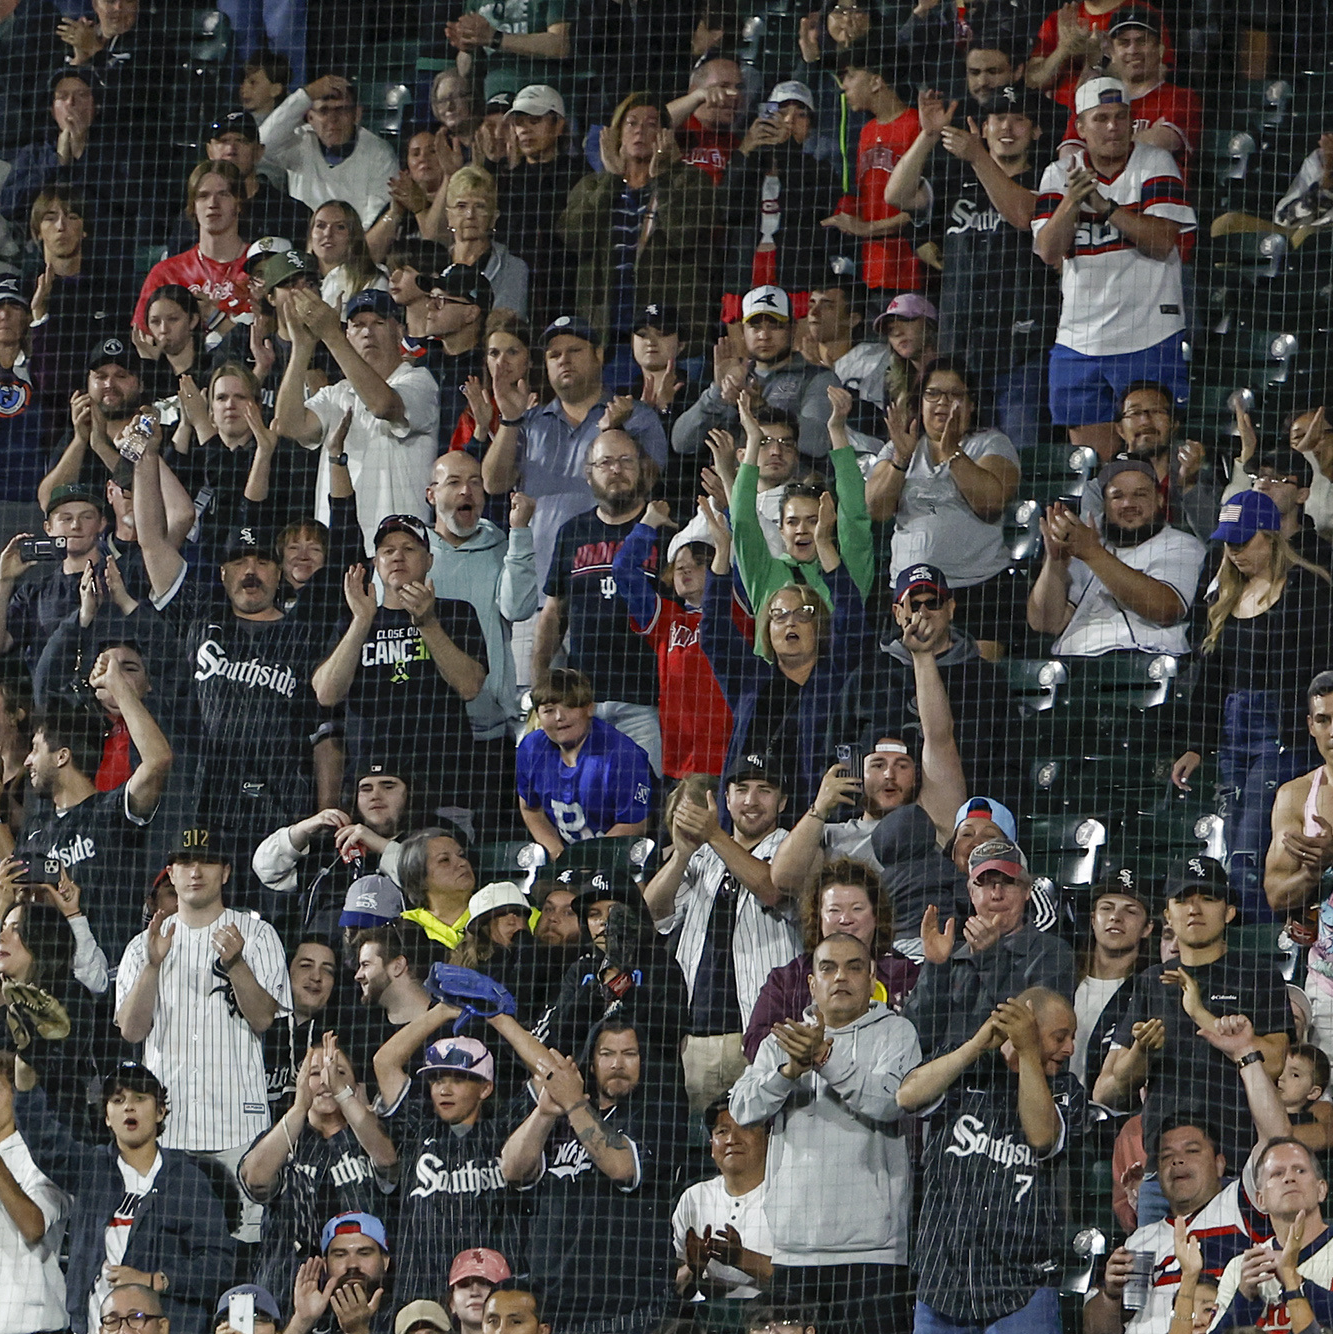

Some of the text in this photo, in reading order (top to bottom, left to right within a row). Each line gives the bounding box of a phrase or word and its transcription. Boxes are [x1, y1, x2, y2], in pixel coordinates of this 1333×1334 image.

[195, 640, 297, 699] Southside
[183, 830, 209, 847] 312
[1015, 1174, 1034, 1203] 7
